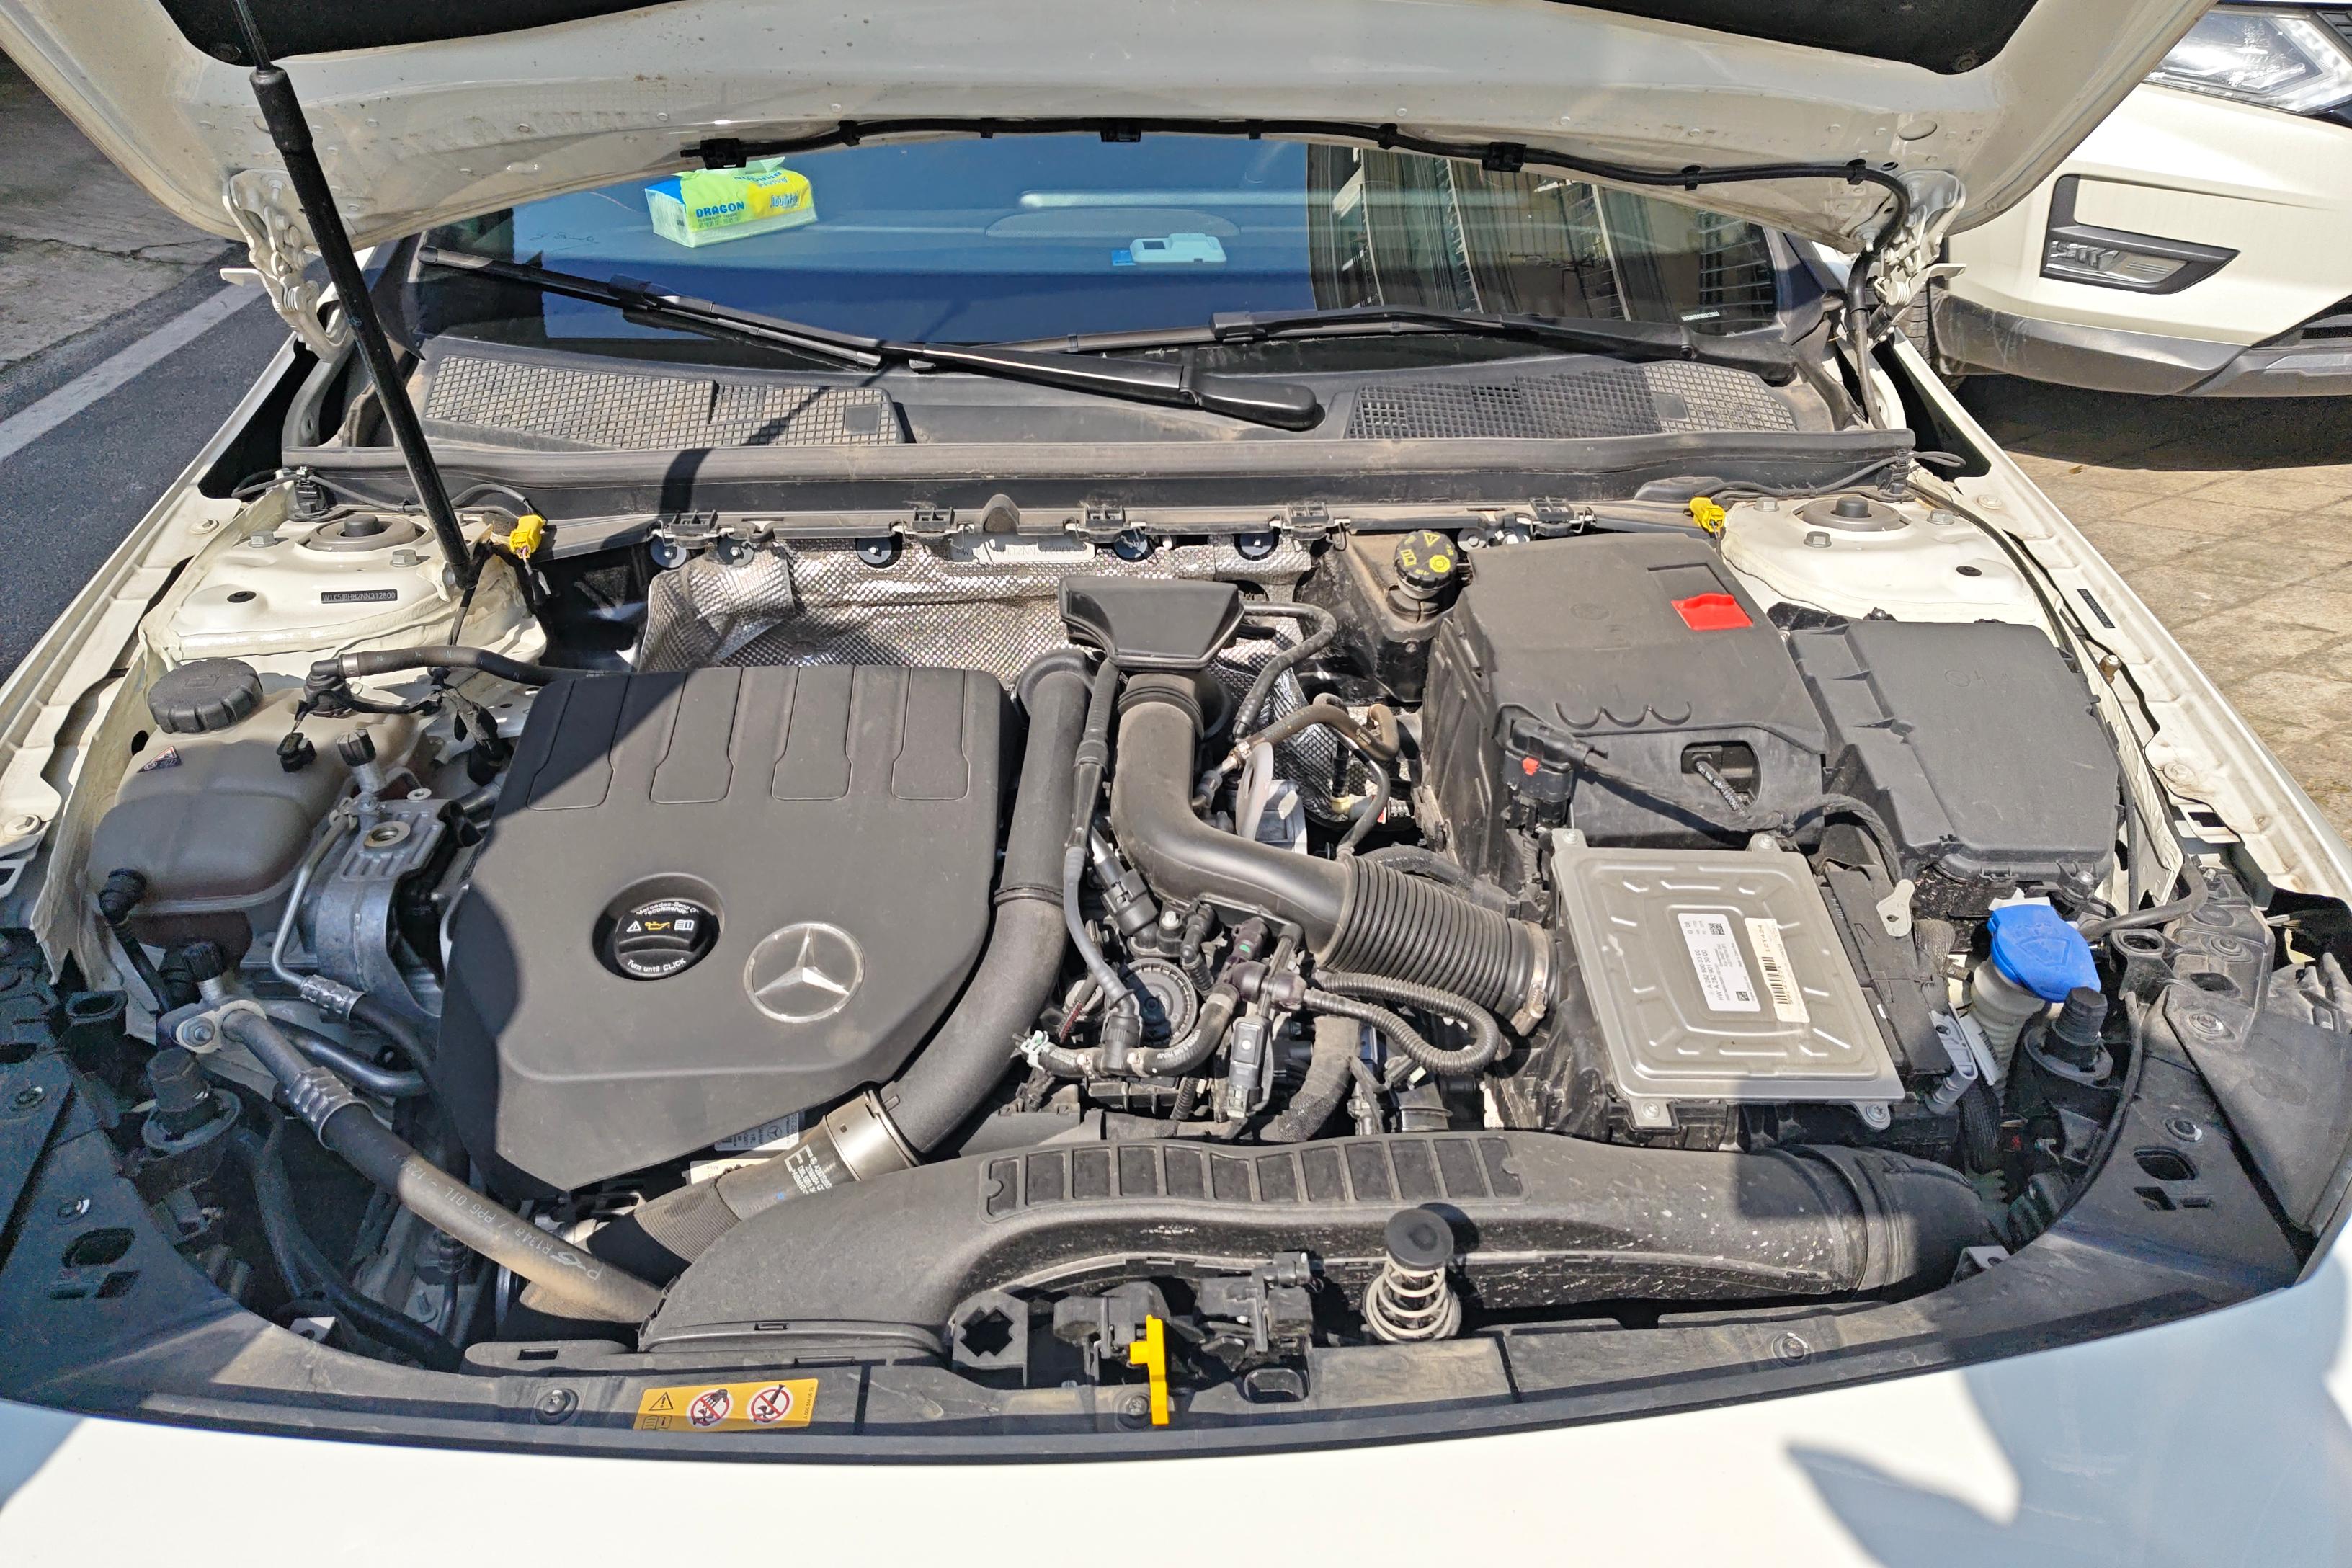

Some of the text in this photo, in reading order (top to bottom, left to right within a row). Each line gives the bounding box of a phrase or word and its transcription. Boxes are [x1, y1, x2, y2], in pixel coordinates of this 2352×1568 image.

[695, 201, 745, 218] DRAGON
[627, 959, 641, 971] Turn
[663, 957, 687, 972] CLICK
[444, 1186, 468, 1206] OIL
[469, 1203, 496, 1224] PPG
[514, 1227, 553, 1255] R134a
